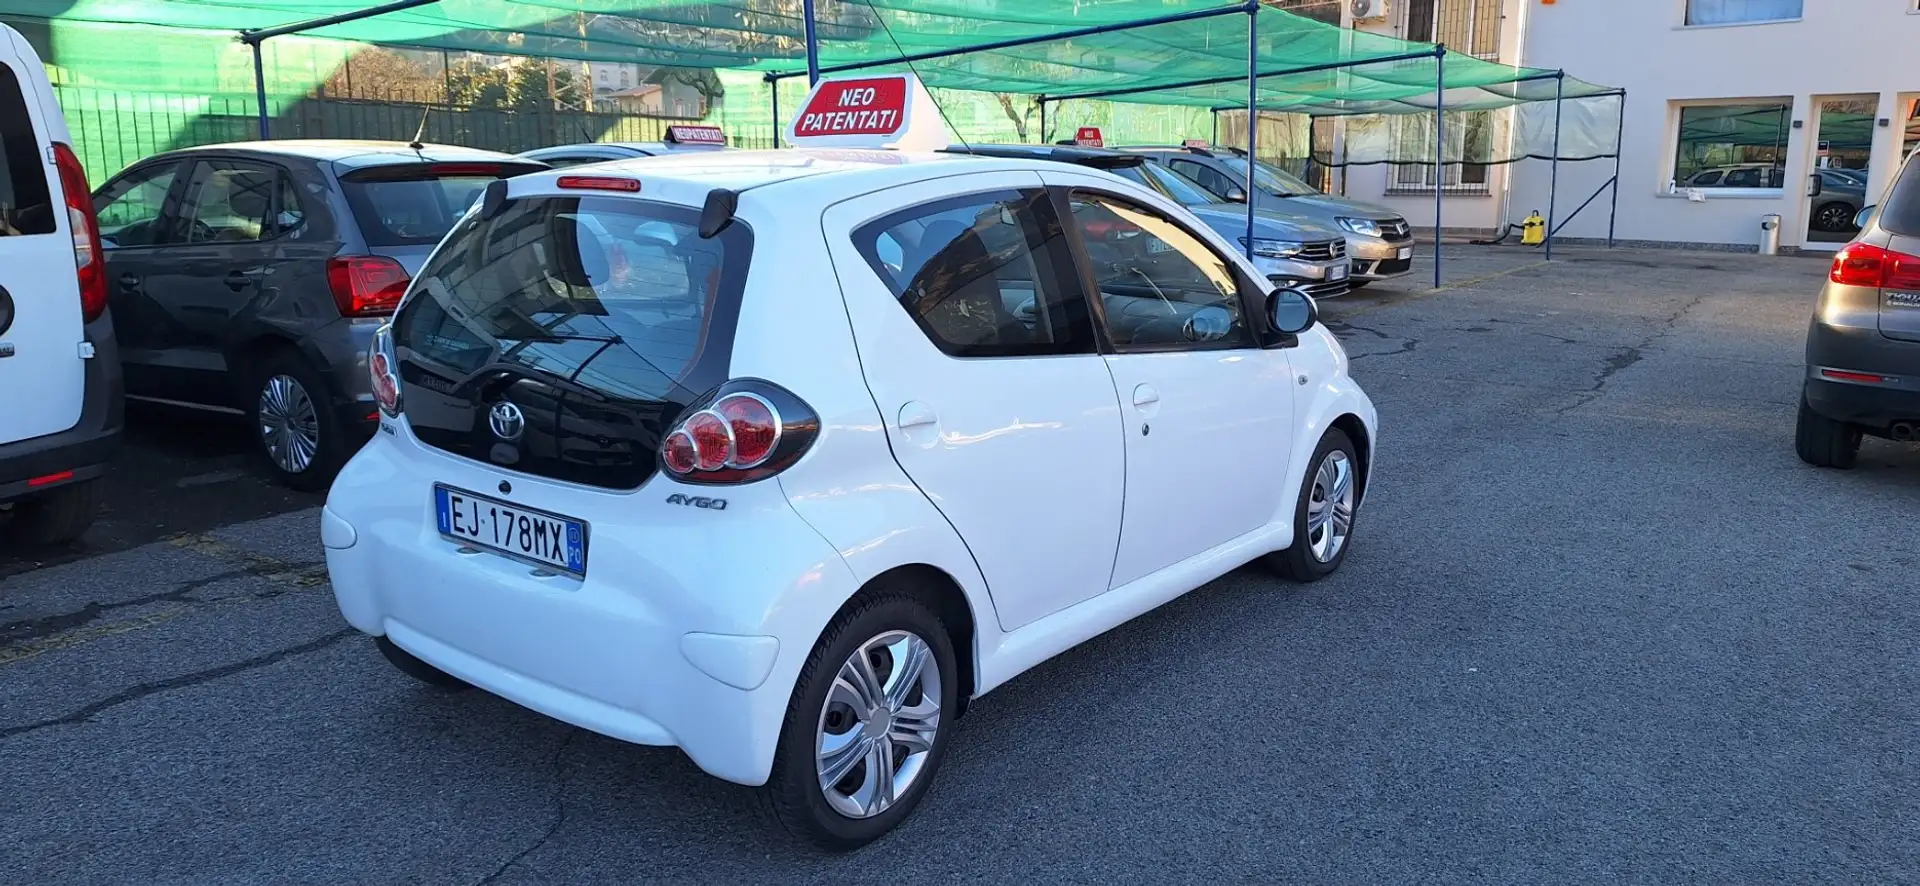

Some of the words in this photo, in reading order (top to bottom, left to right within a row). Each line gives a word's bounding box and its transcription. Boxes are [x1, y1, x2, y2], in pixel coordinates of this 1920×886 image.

[838, 87, 875, 107] NEO
[801, 109, 897, 132] PATENTATI
[666, 493, 728, 511] AYGO
